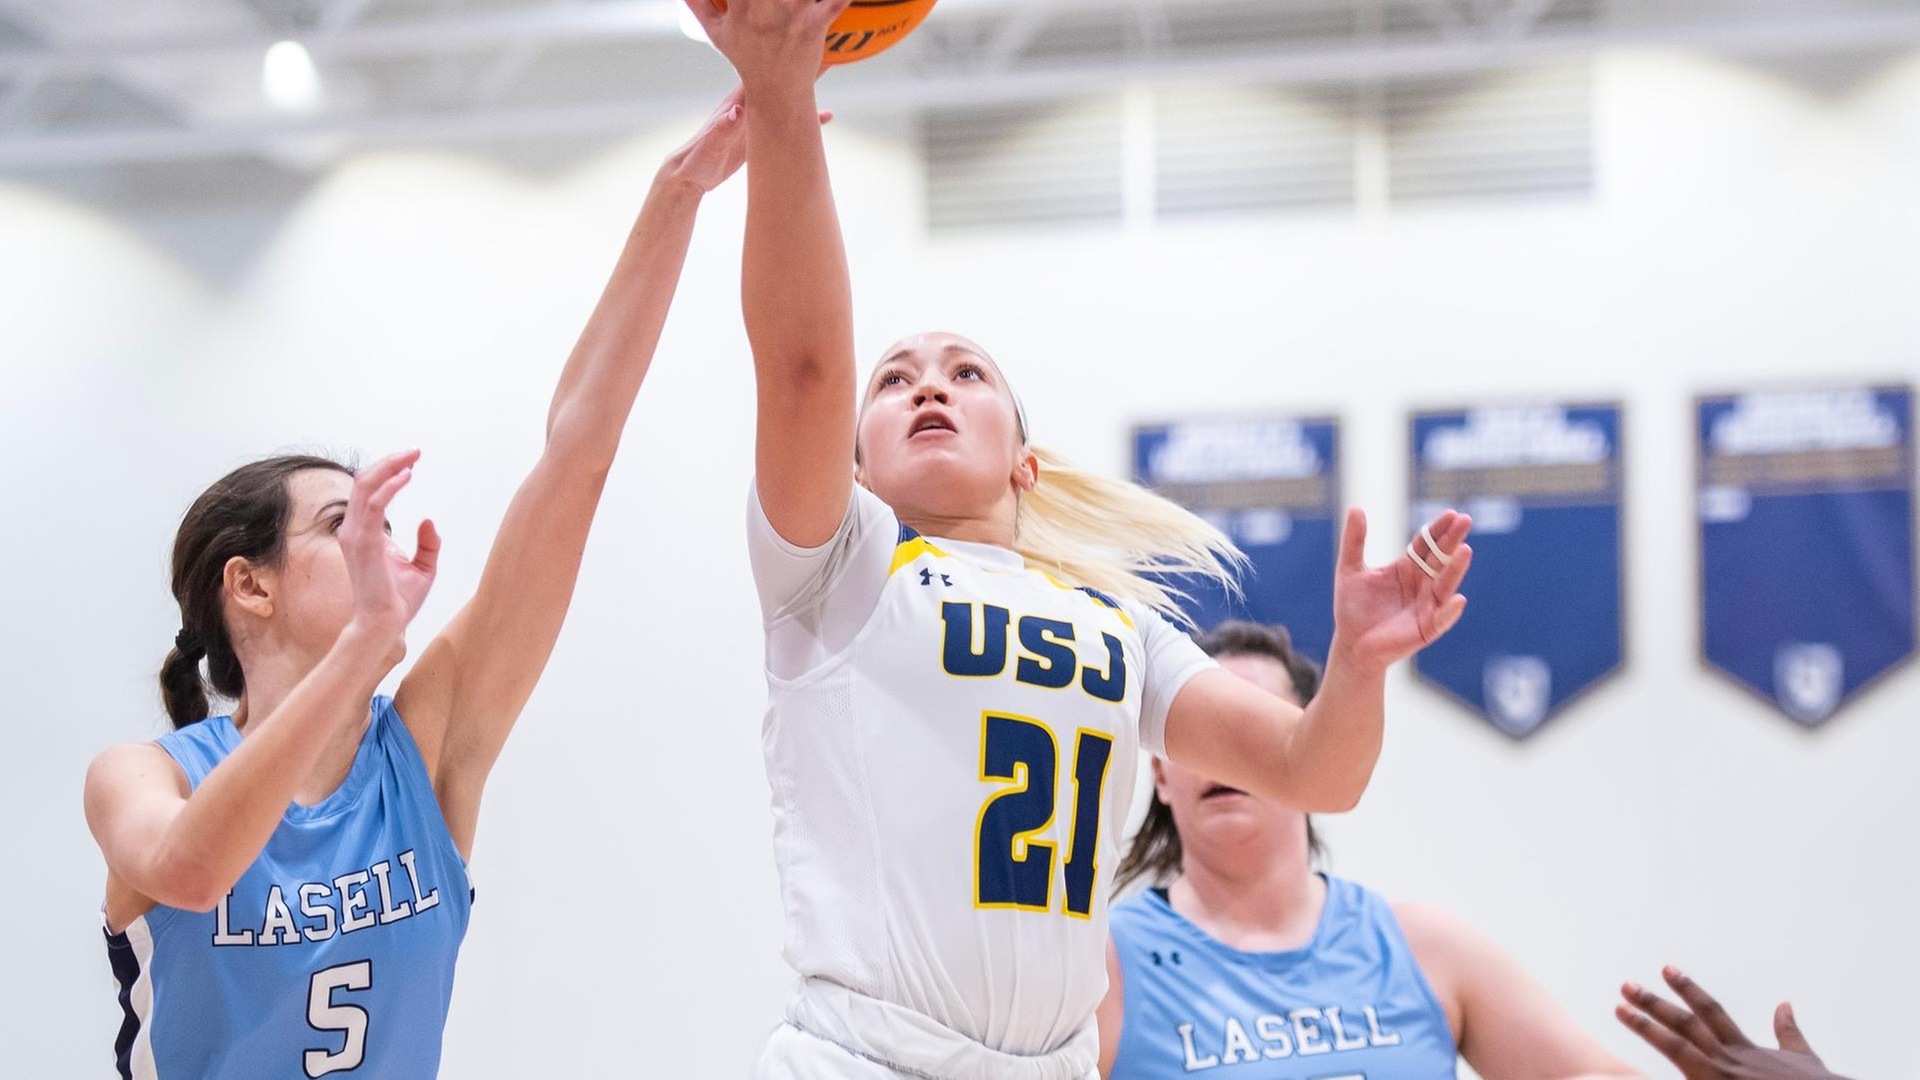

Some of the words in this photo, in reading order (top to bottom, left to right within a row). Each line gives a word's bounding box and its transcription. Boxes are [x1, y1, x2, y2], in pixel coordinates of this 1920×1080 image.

[941, 600, 1126, 703] USJ
[973, 710, 1115, 920] 21
[212, 848, 439, 947] LASELL
[302, 958, 373, 1080] 5
[1177, 1003, 1401, 1073] LASELL
